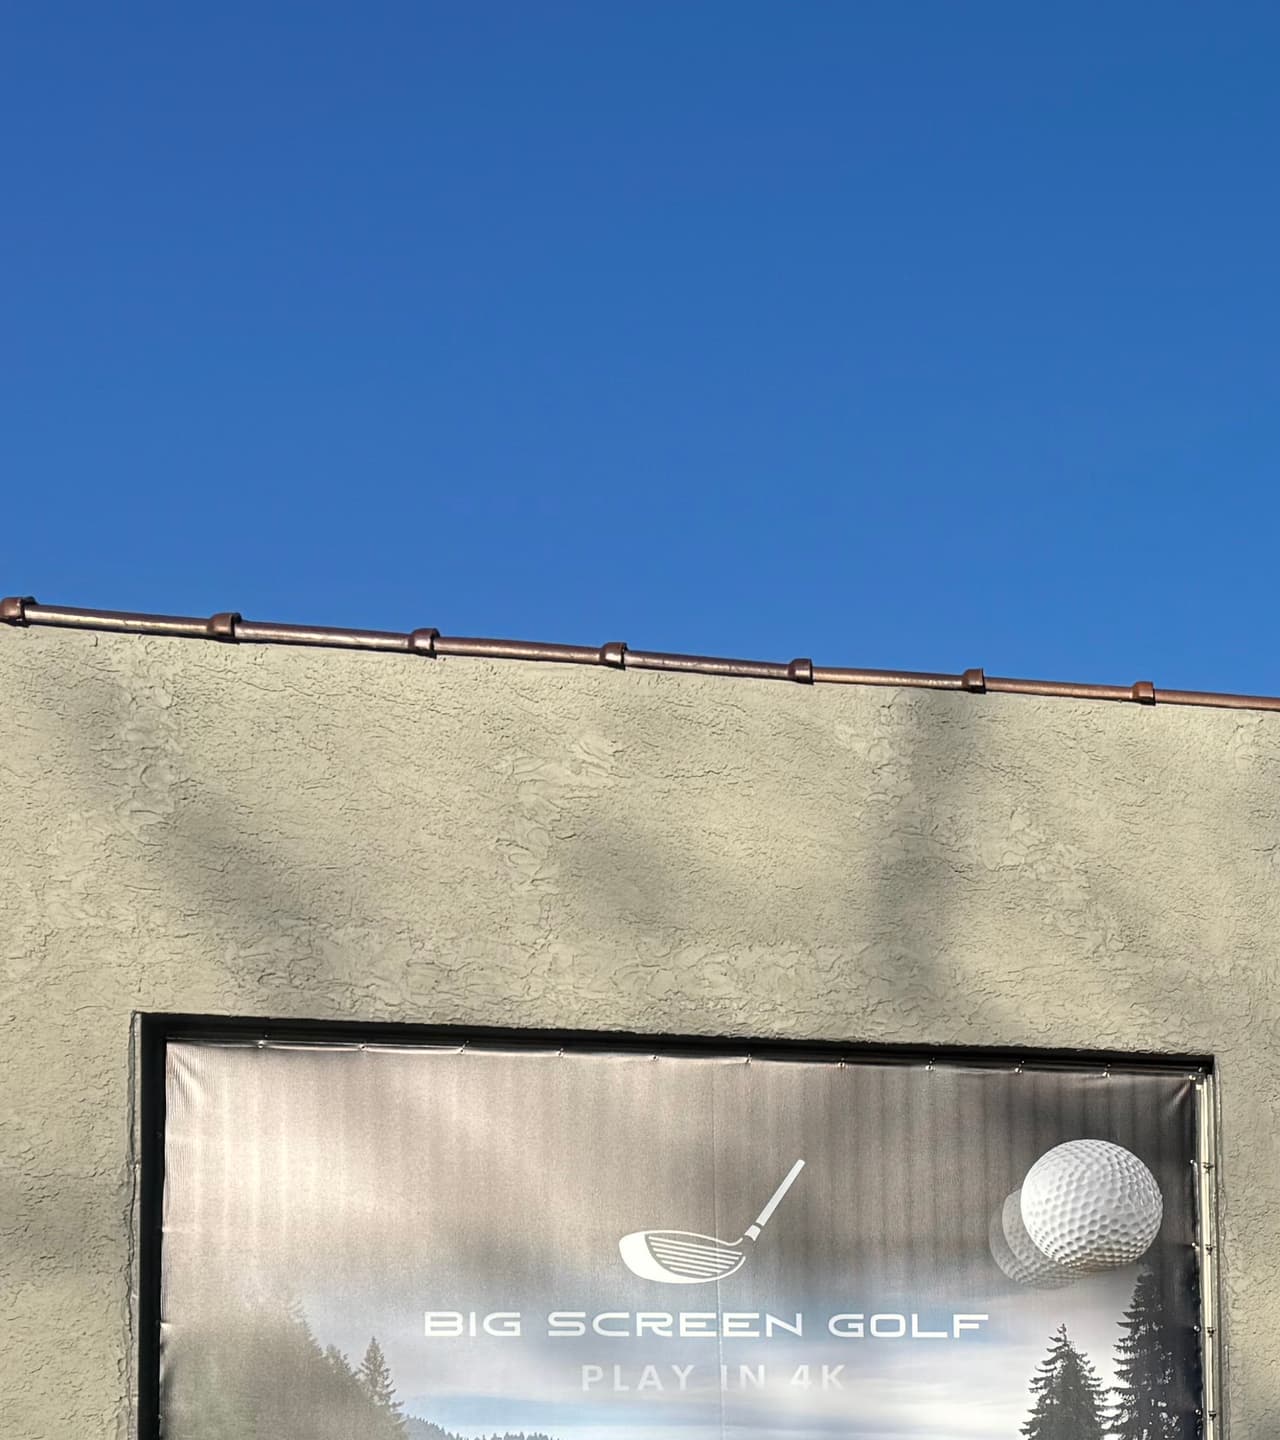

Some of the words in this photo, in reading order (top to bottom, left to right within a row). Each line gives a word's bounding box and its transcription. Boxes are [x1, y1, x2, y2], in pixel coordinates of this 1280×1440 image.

[423, 1310, 522, 1338] BIG
[546, 1310, 804, 1339] SCREEN
[827, 1313, 990, 1339] GOLF
[580, 1363, 697, 1392] PLAY
[719, 1363, 767, 1391] IN
[788, 1363, 847, 1390] 4K
